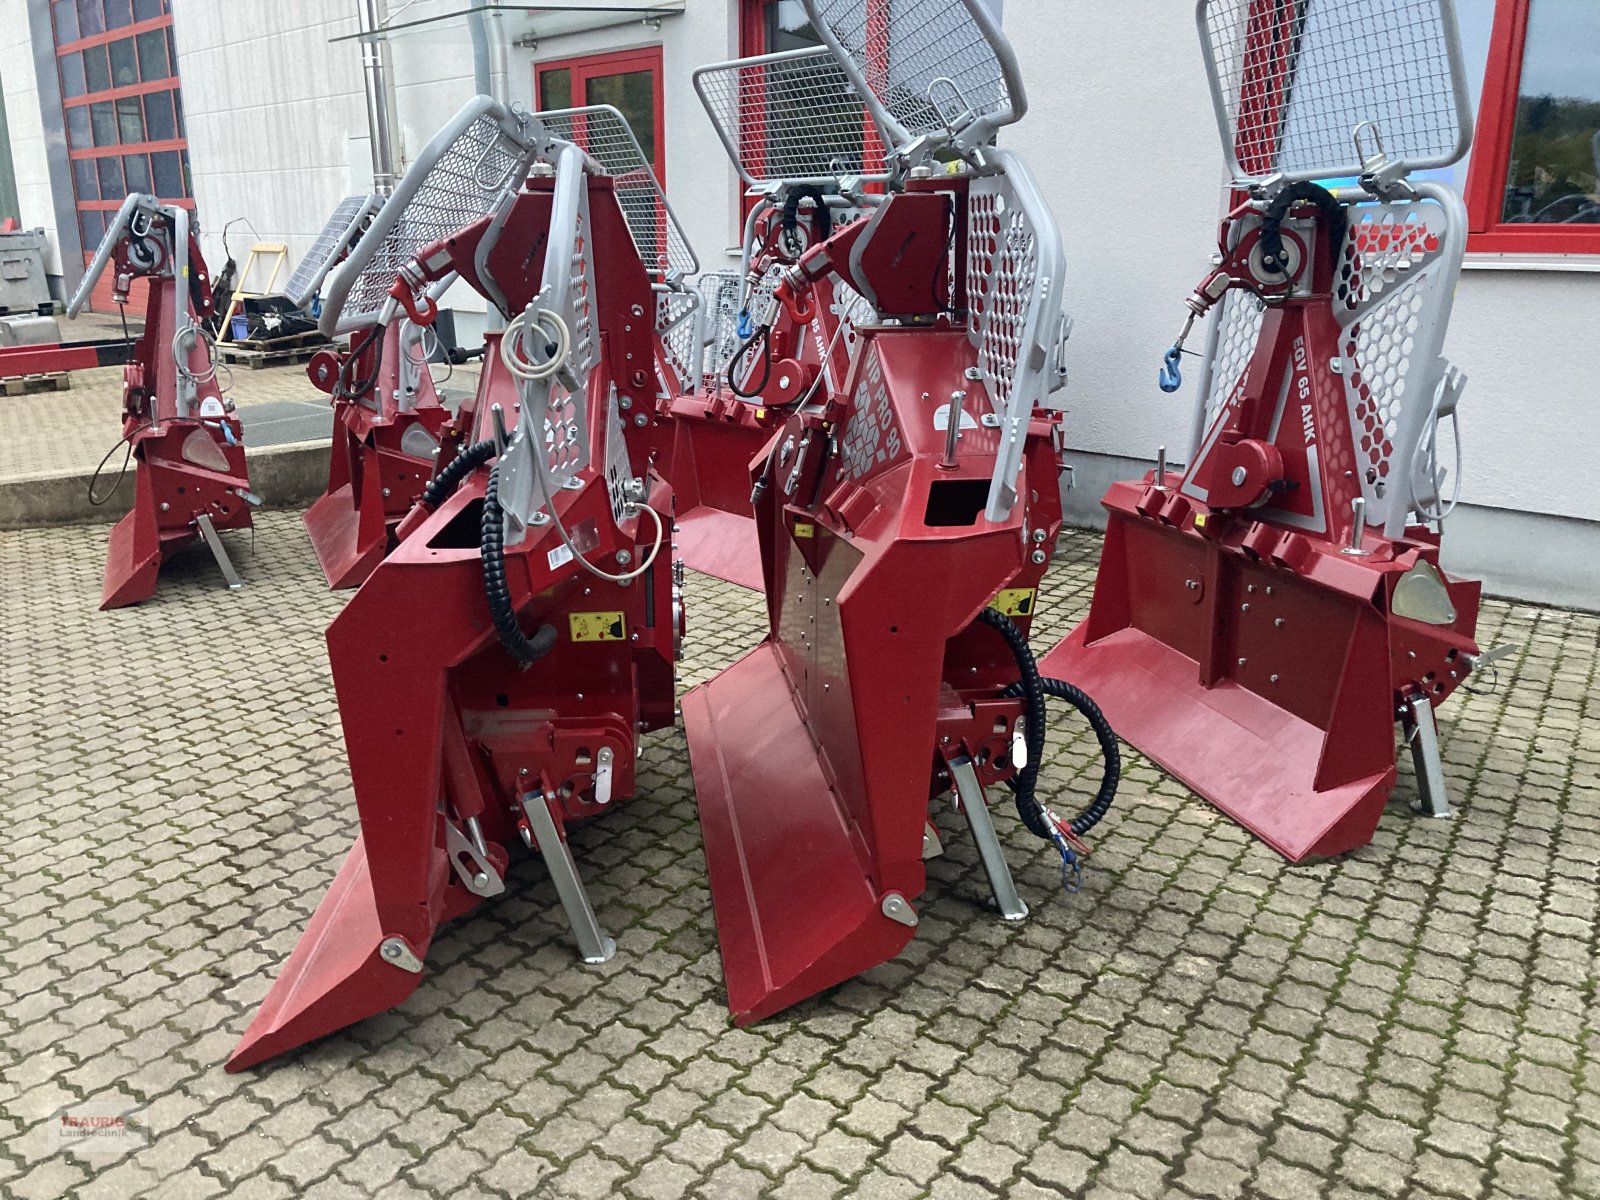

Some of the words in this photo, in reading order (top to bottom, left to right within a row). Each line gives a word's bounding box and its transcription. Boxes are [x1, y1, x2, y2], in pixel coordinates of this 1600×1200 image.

[811, 318, 820, 333] 85
[815, 335, 828, 362] AHK
[1292, 335, 1307, 371] EGV
[1297, 376, 1310, 399] 65
[866, 348, 880, 384] VIP
[874, 382, 893, 431] PRO
[886, 427, 901, 460] 90
[1301, 404, 1316, 443] AHK
